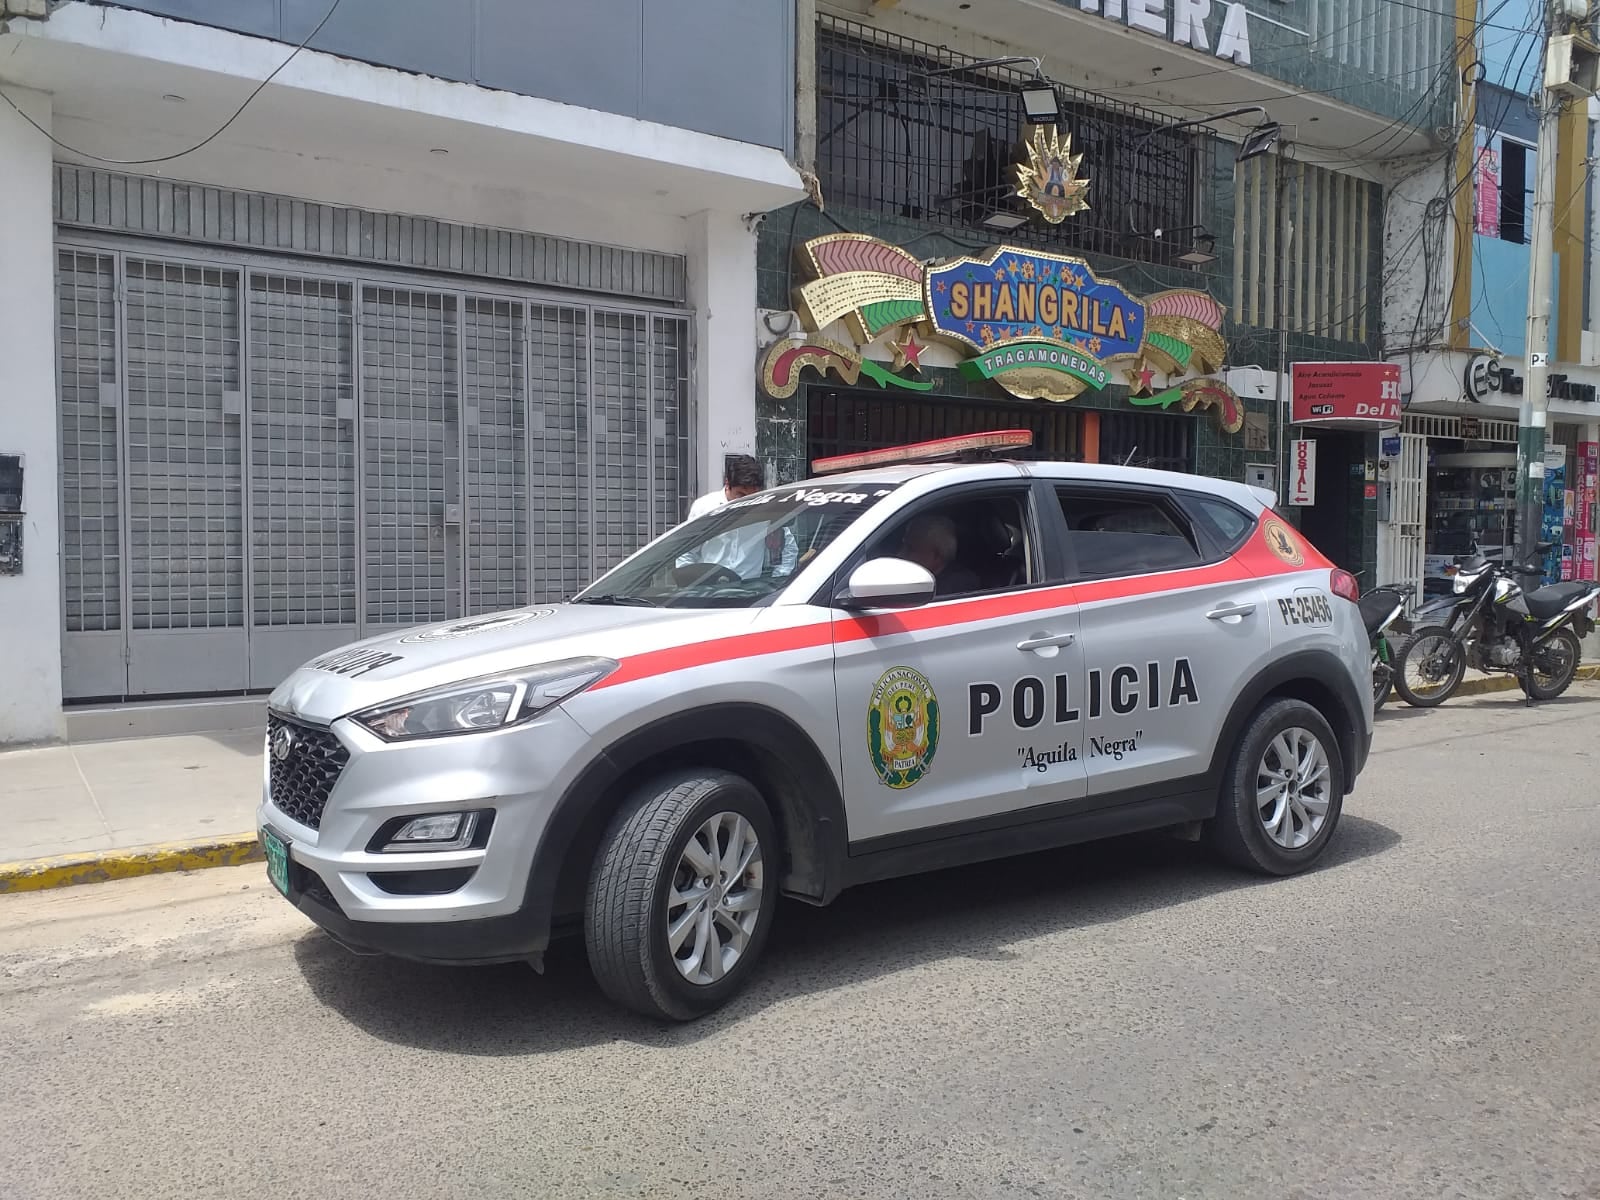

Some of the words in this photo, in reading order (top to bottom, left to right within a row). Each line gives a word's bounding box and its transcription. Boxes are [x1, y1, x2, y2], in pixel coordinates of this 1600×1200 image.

[950, 281, 1128, 340] SHANGRILA
[984, 350, 1106, 383] TRAGAMONEDAS
[1355, 403, 1386, 415] Del
[1297, 441, 1308, 493] HOSTAL
[1575, 457, 1585, 530] BRACKETS
[1277, 595, 1333, 625] PE-25456
[875, 672, 897, 700] POLICIA
[897, 670, 928, 695] NACIONAL
[887, 683, 898, 696] DEL
[968, 657, 1199, 736] POLICIA
[1017, 741, 1078, 772] "Aguila
[1089, 730, 1143, 761] Negra"
